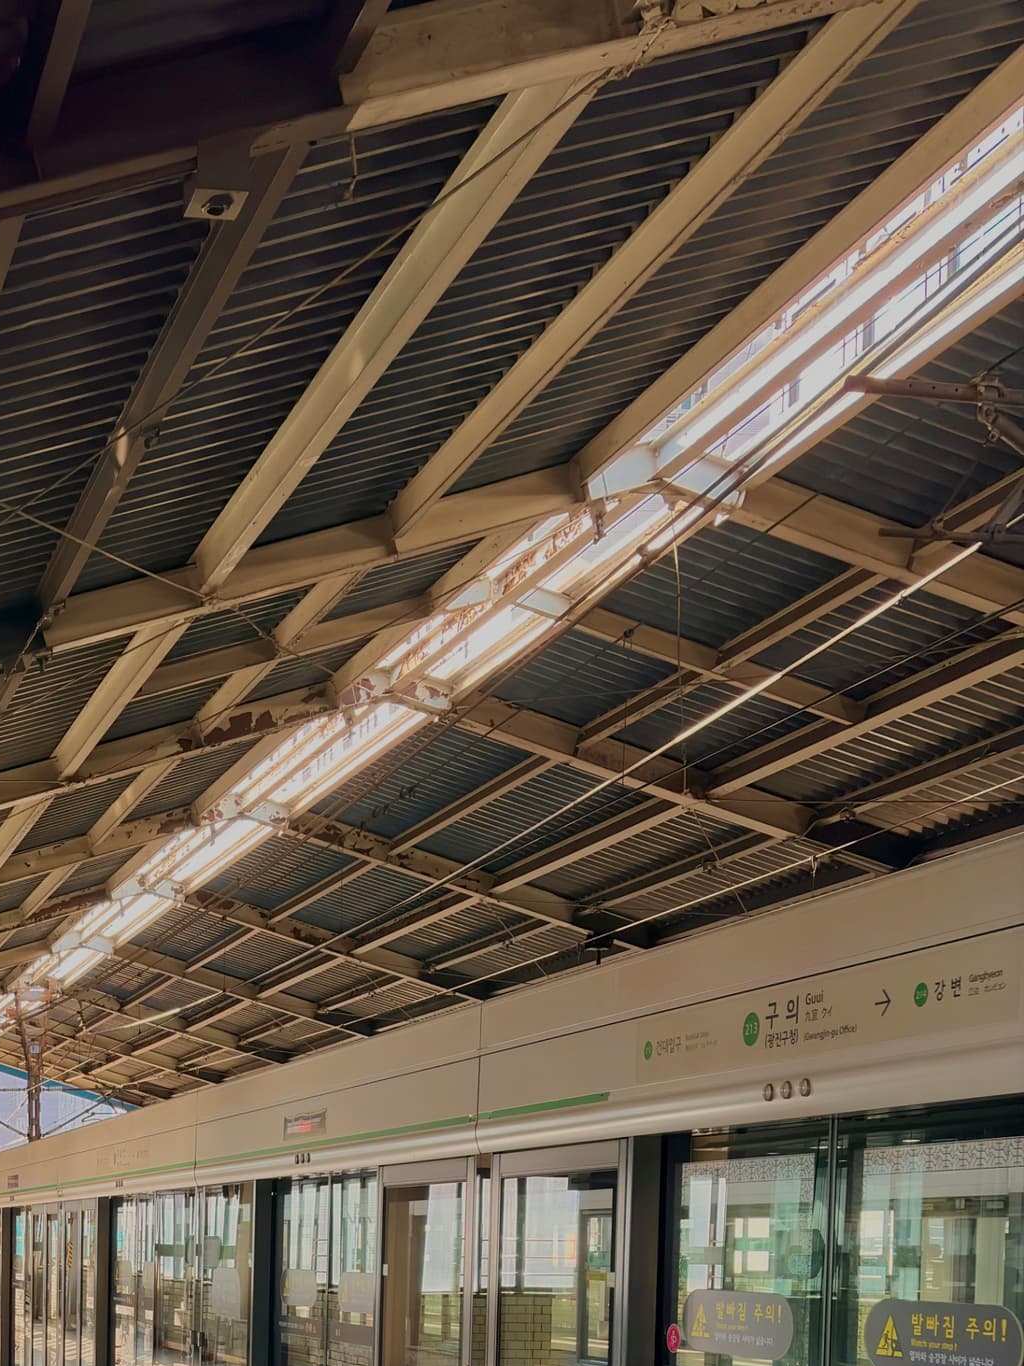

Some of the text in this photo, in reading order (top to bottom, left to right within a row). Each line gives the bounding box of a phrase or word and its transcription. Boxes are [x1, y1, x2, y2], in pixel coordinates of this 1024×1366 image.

[805, 989, 825, 1006] Guui
[934, 976, 961, 1001] 강변
[765, 995, 800, 1030] 구의
[744, 1021, 759, 1036] 213
[911, 1312, 1008, 1343] 발빠짐 주의!
